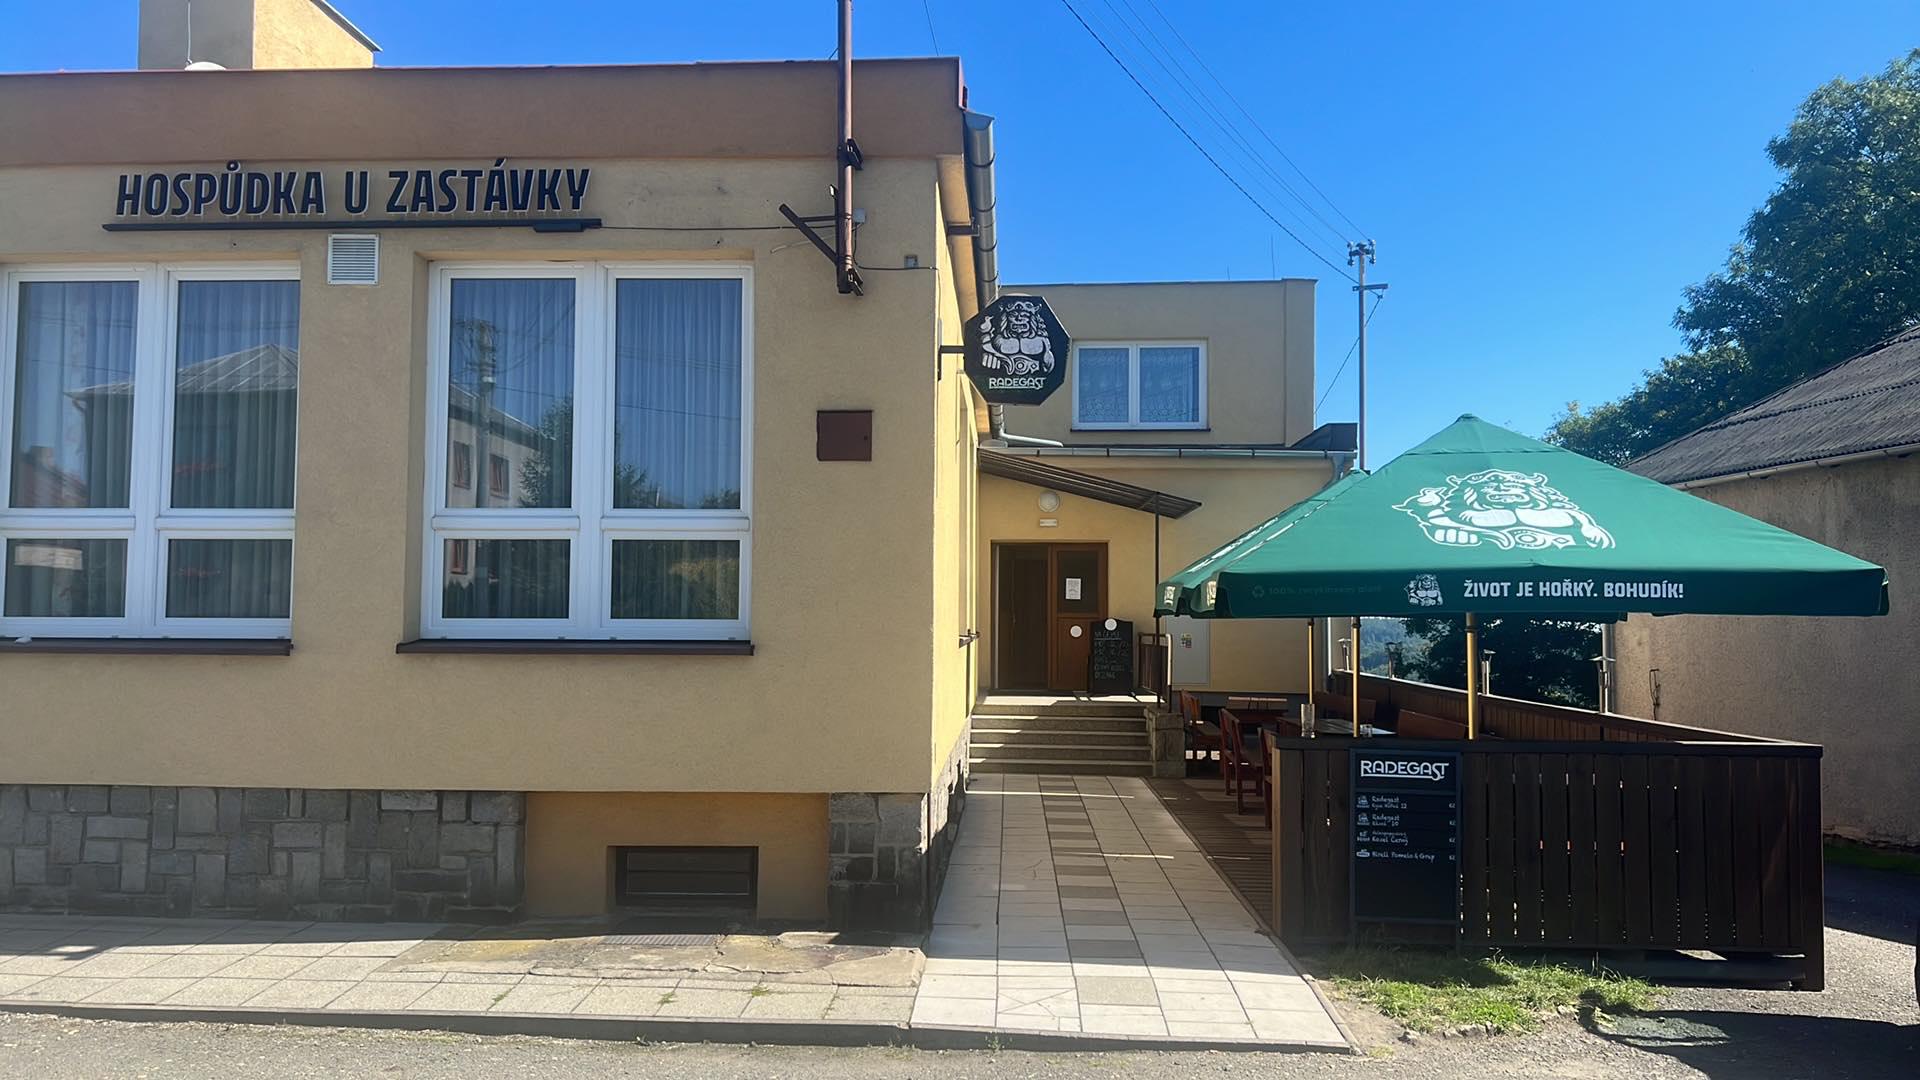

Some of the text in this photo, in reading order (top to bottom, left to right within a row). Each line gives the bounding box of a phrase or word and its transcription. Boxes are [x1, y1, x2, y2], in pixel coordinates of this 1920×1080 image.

[116, 157, 590, 217] HOSPŮDKA U ZASTÁVKY
[989, 377, 1047, 390] RADEGAST
[1464, 579, 1684, 599] ŽIVOT JE HOŘKÝ. BOHUDÍK!
[1361, 760, 1450, 781] RADEGAST
